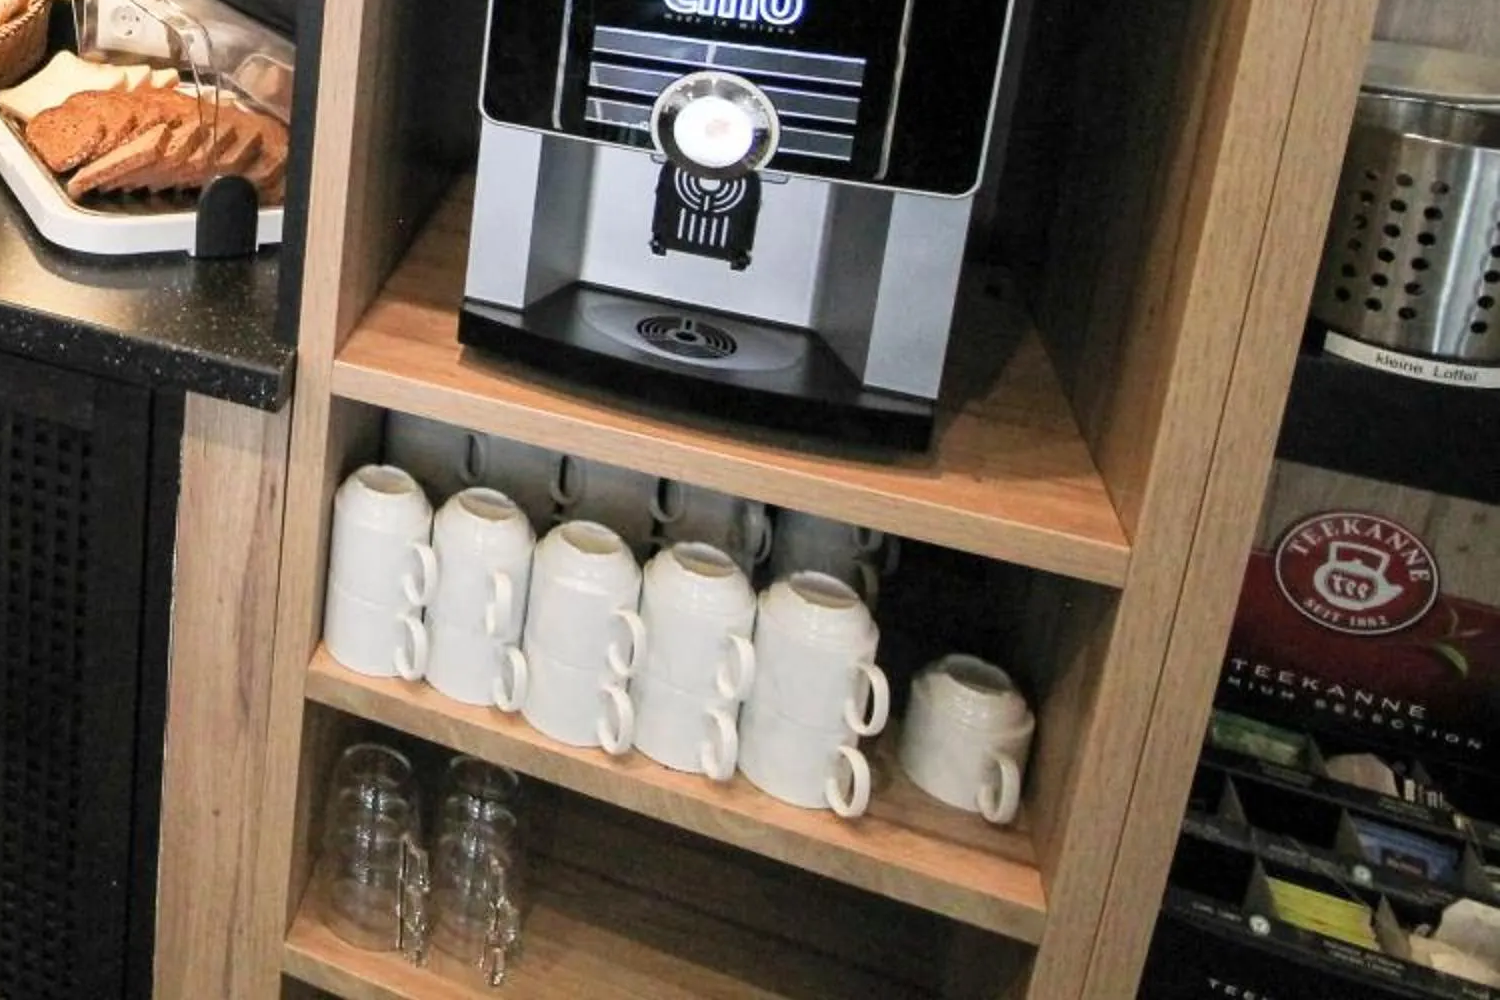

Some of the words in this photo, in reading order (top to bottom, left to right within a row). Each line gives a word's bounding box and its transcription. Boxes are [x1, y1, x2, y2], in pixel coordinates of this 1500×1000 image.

[1375, 352, 1424, 375] kleine
[1288, 518, 1431, 582] TEEKANNE
[1302, 598, 1342, 623] SEIT
[1350, 614, 1389, 627] 1882
[1231, 658, 1428, 719] TEEKANNE
[1314, 699, 1482, 750] SELECTION
